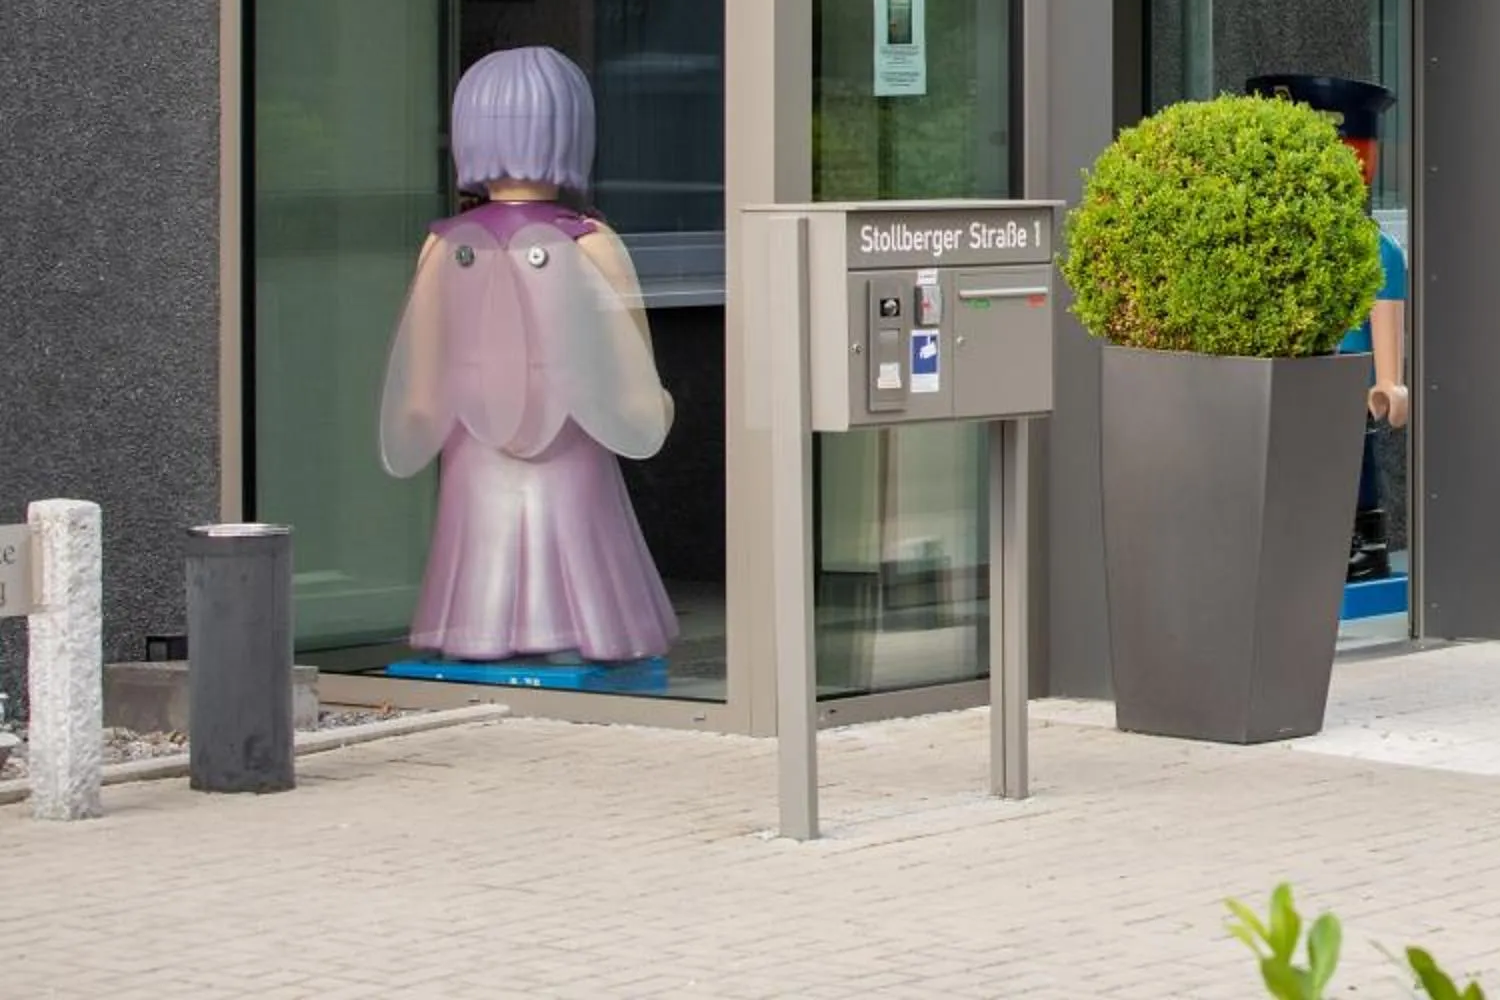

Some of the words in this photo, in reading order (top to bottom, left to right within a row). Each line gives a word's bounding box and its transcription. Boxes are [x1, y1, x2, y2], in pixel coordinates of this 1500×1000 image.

[860, 224, 962, 256] Stollberger
[969, 220, 1027, 249] Straße
[1033, 220, 1041, 248] 1
